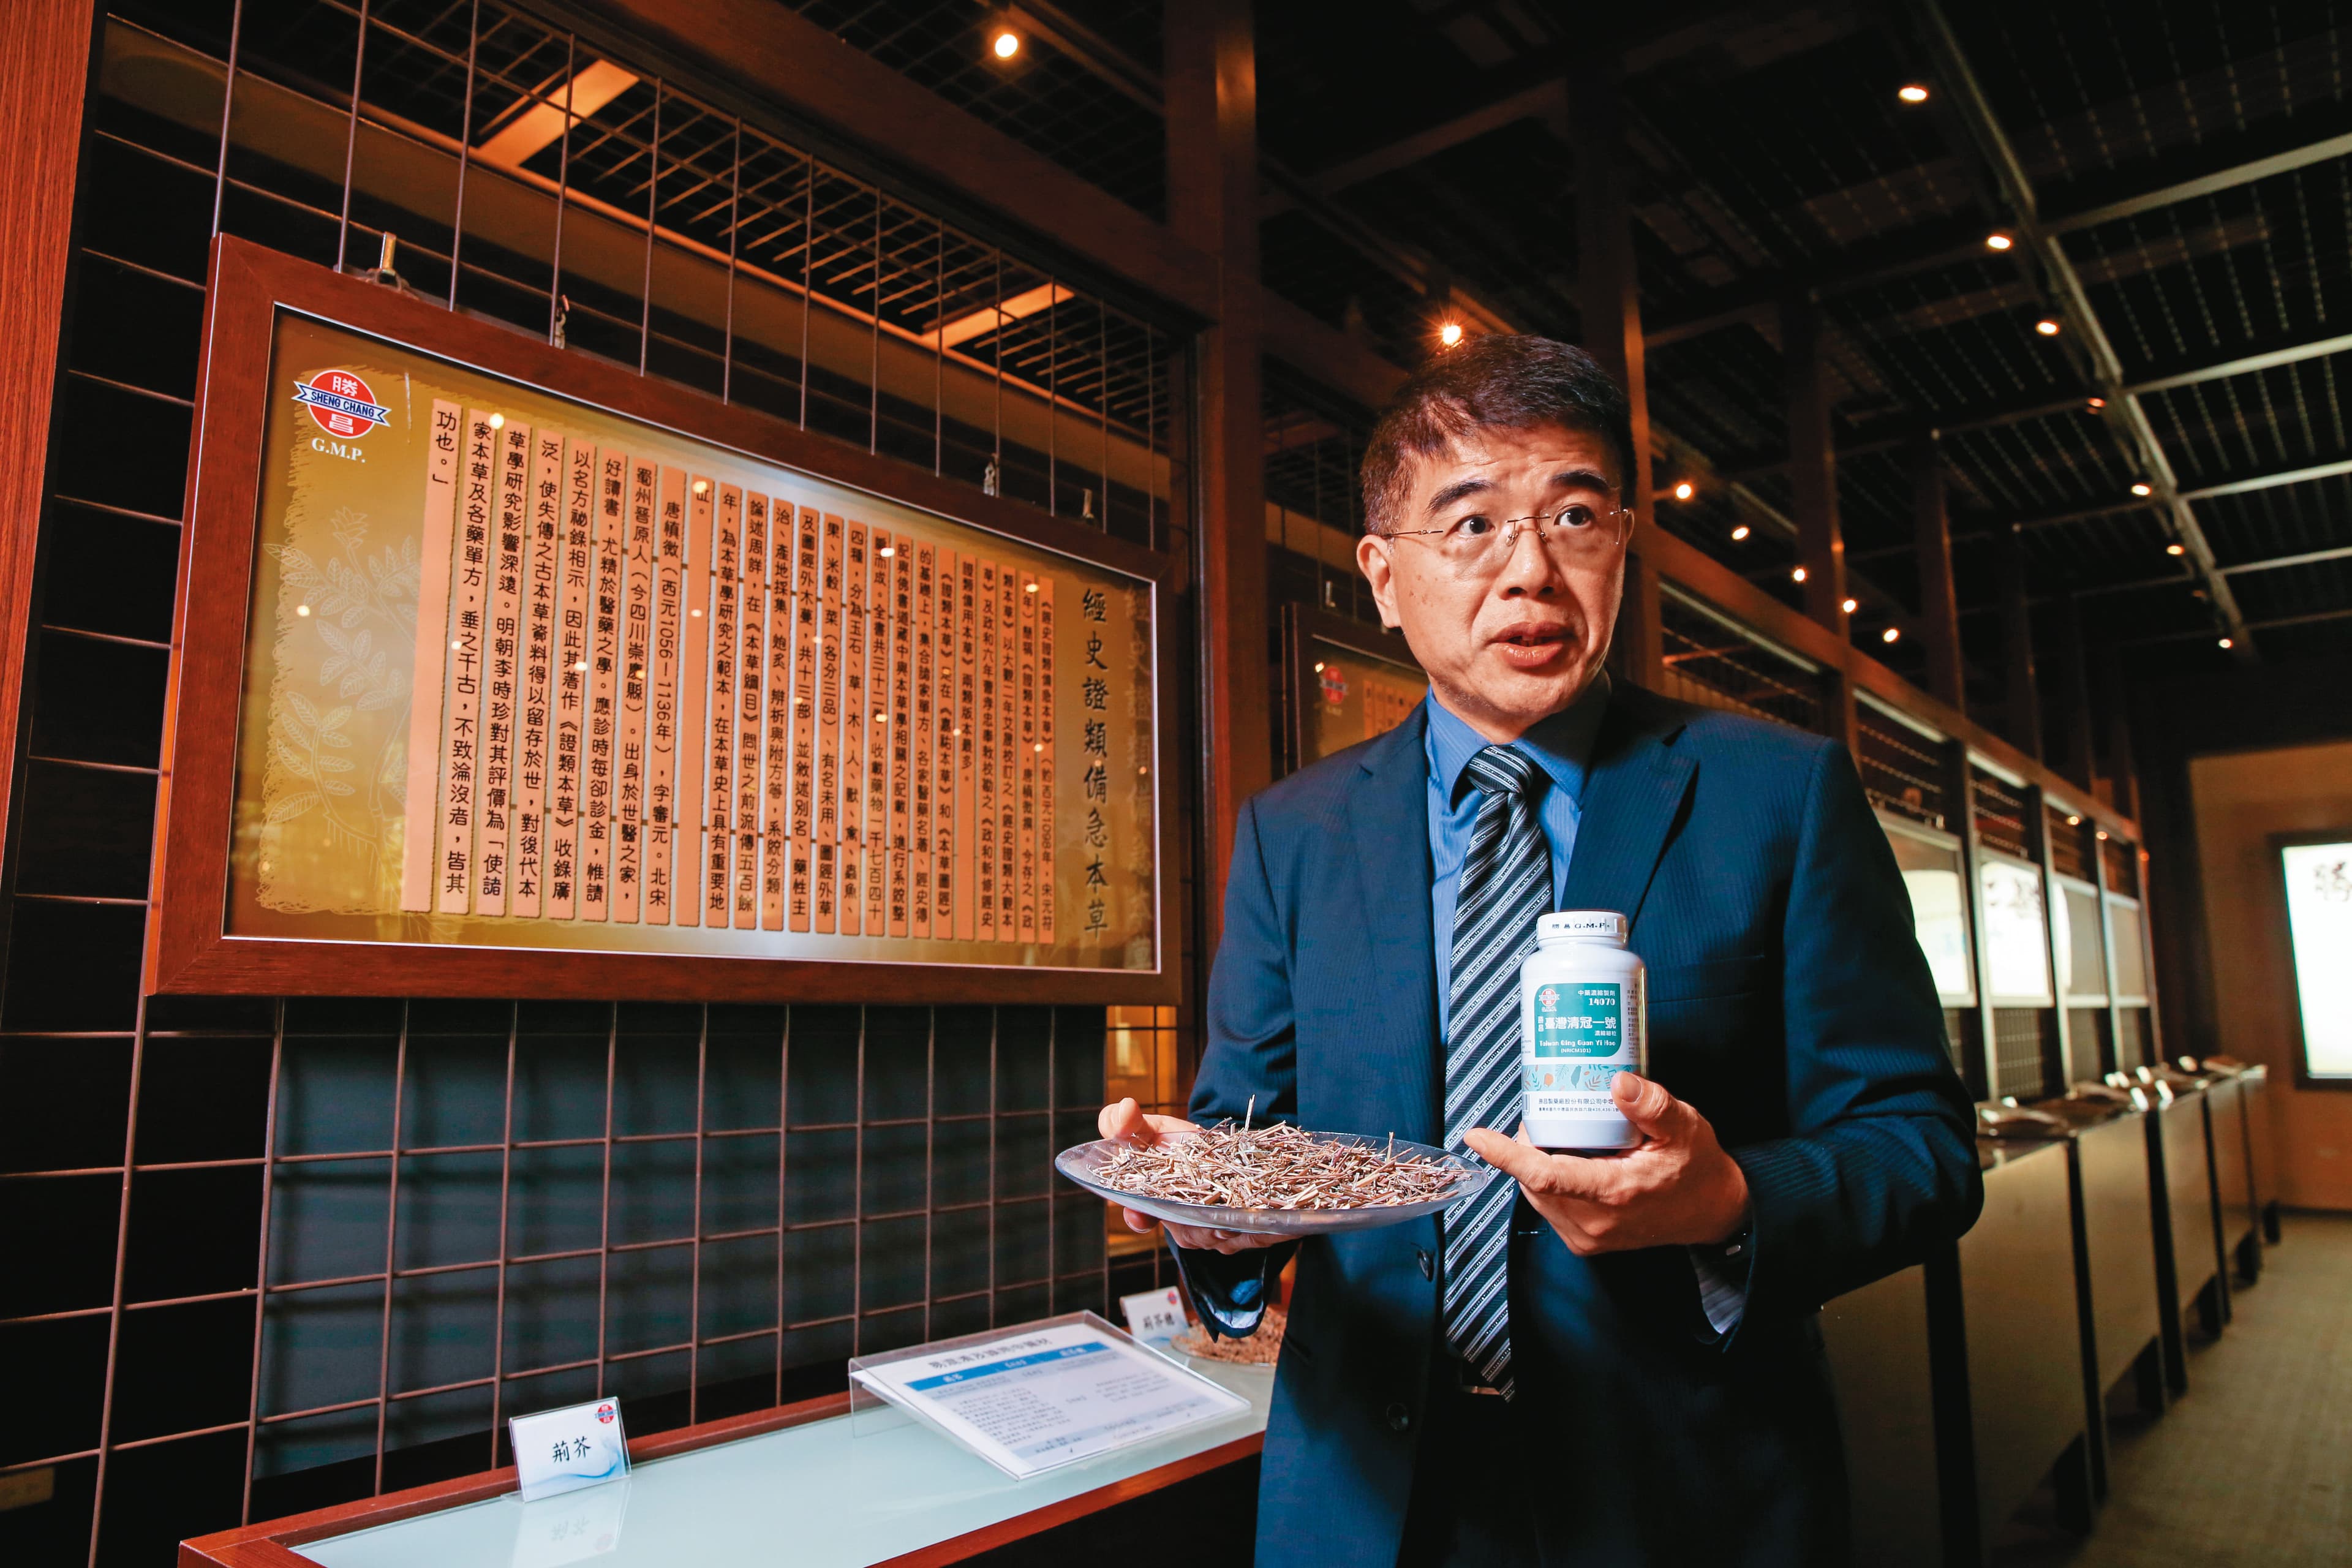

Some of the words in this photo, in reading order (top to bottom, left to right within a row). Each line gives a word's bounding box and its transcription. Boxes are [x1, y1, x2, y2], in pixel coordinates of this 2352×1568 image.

[332, 375, 358, 396] 勝
[311, 391, 341, 408] SHENG
[343, 400, 375, 418] CHANG
[328, 413, 353, 434] 昌
[311, 437, 366, 464] G.M.P.
[1082, 588, 1109, 939] 經史證類備急本草
[1545, 1016, 1616, 1030] 臺灣清冠一號
[552, 1436, 592, 1463] 荊芥
